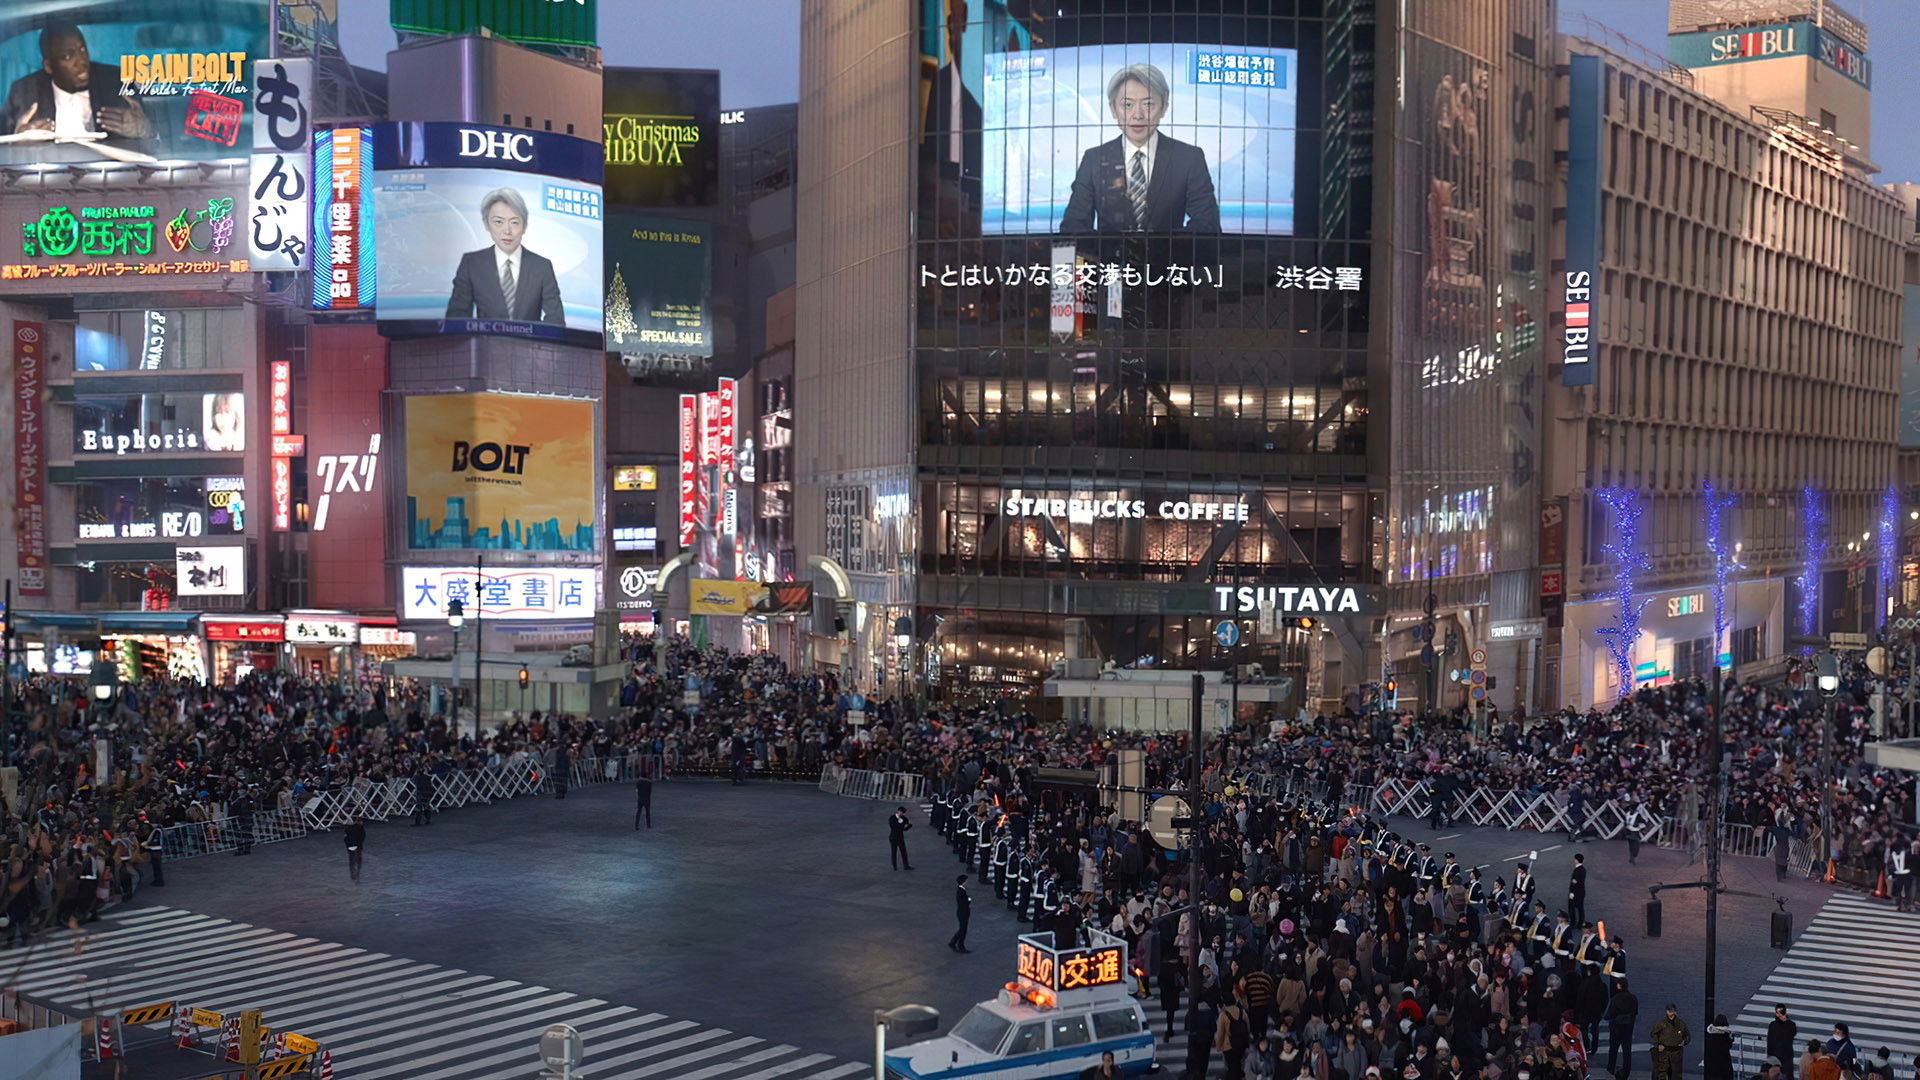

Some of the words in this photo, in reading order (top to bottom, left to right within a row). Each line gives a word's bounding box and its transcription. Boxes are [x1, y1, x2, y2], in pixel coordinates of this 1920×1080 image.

[1711, 28, 1794, 61] SEIBU
[1820, 35, 1867, 85] SEIBU
[120, 53, 188, 84] USAIN
[191, 52, 246, 82] BOLT
[459, 129, 533, 162] DHC
[617, 117, 700, 142] Christmas
[253, 63, 307, 266] もんじゃ
[329, 135, 353, 299] 三千里薬品
[81, 220, 154, 256] 西村
[1276, 265, 1363, 291] 渋谷署
[1564, 271, 1591, 365] SEIBU
[641, 330, 678, 343] SPECIAL
[679, 331, 702, 344] SALE
[83, 429, 198, 455] Euphoria
[452, 441, 530, 475] BOLT
[1006, 497, 1146, 519] STARBUCKS
[1158, 501, 1249, 521] COFFEE
[415, 578, 583, 607] 大盛堂書店
[1215, 586, 1360, 612] TSUTAYA
[1668, 594, 1703, 617] SEIBU
